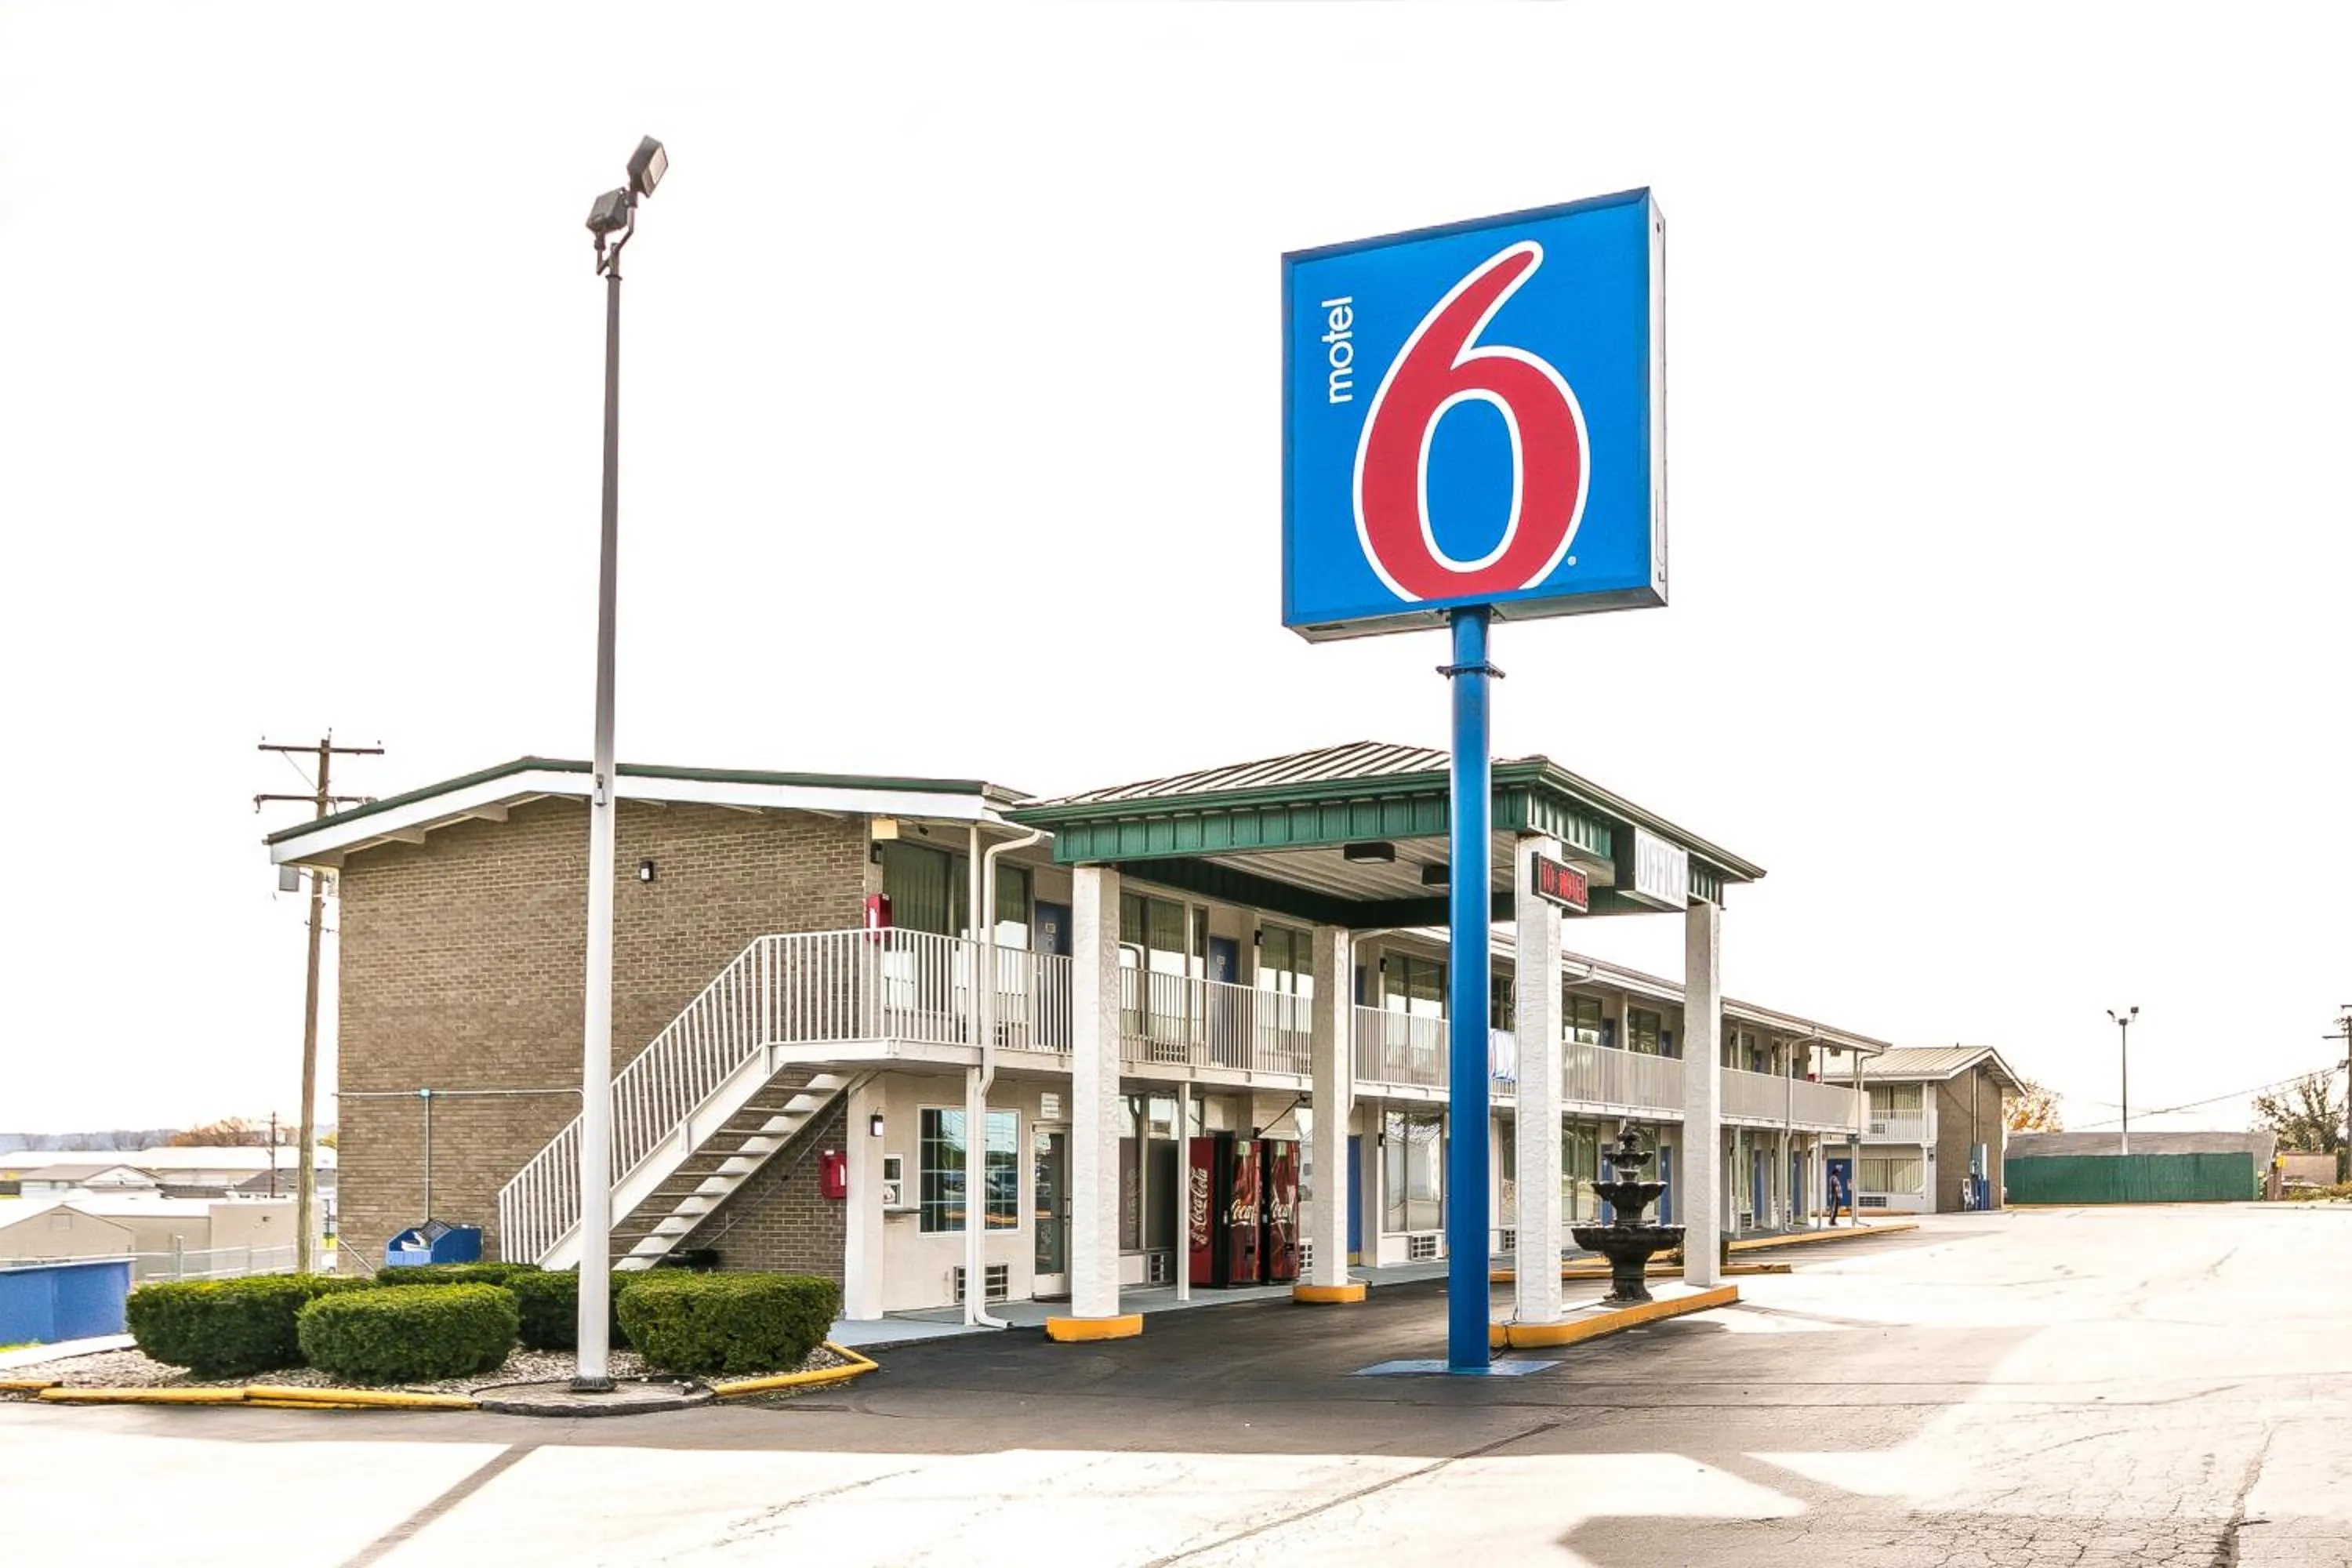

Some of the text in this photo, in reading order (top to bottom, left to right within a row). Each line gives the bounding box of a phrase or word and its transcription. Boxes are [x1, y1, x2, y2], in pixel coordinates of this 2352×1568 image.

[1321, 296, 1354, 404] motel
[1352, 239, 1591, 603] 6
[1636, 837, 1686, 903] OFFICE
